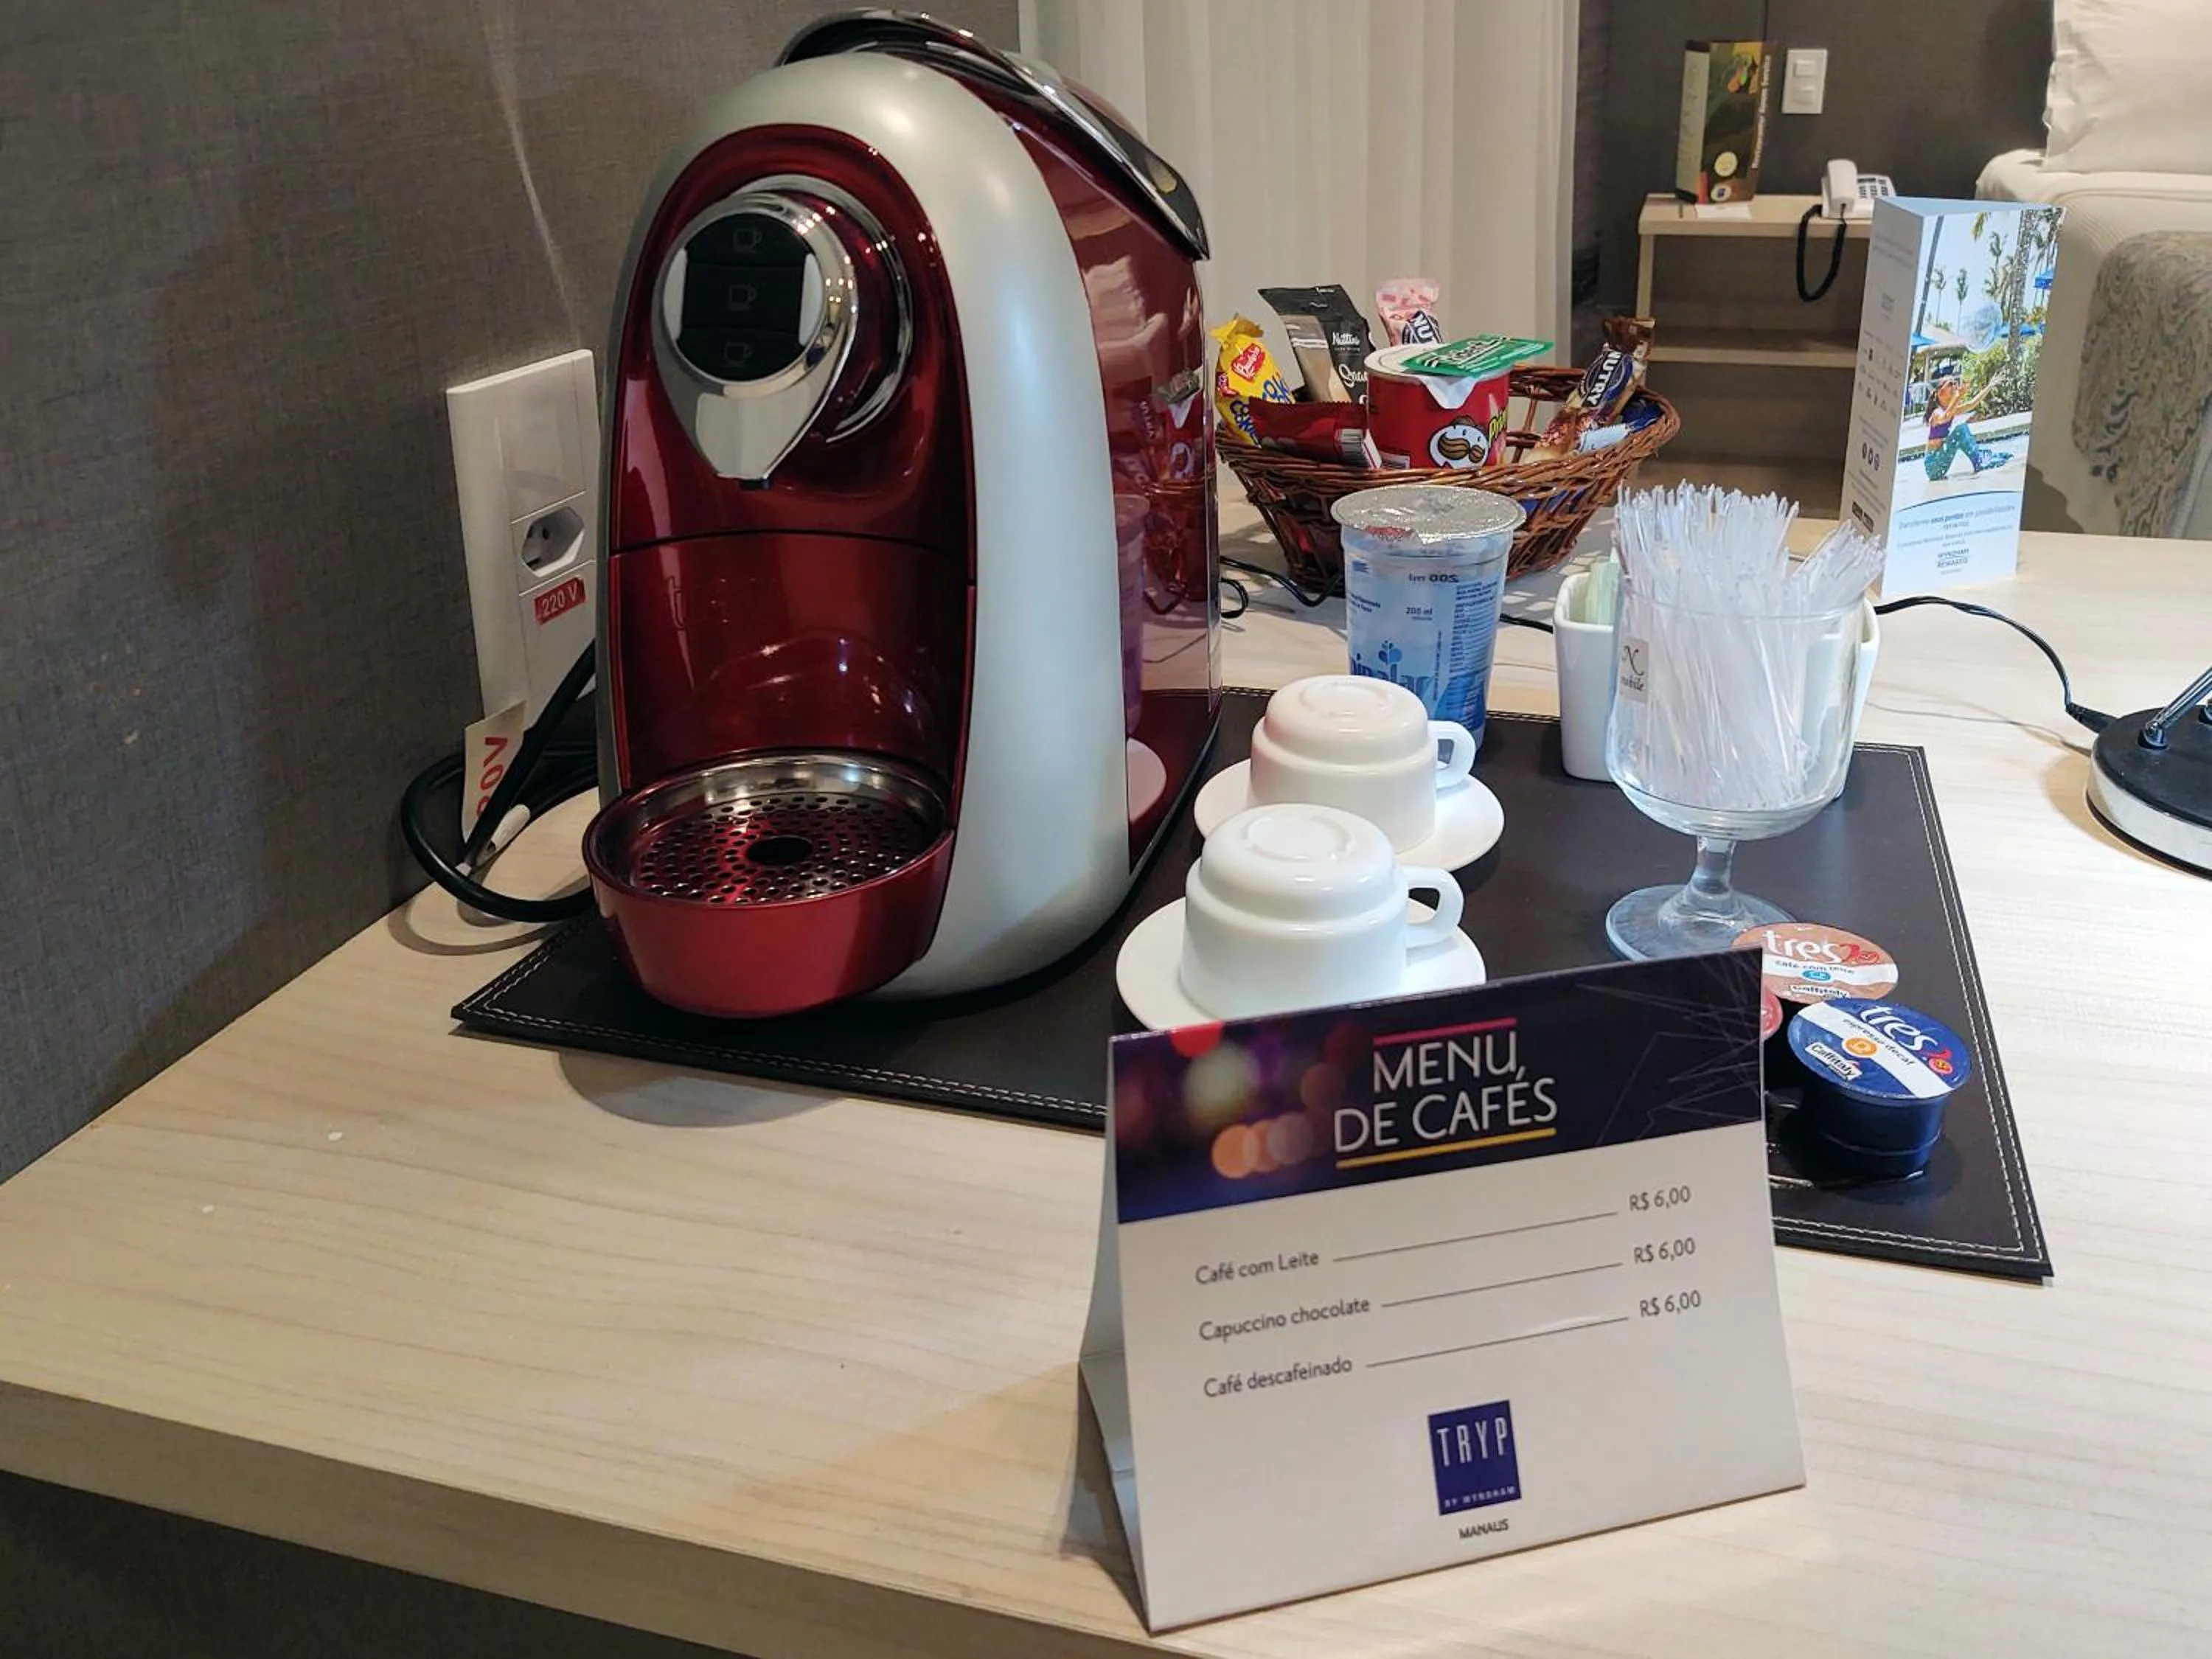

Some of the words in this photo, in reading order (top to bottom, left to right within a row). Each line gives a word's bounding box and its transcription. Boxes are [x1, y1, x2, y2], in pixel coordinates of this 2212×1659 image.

[1586, 350, 1622, 406] NUTRY
[542, 593, 564, 616] 220
[569, 583, 579, 602] V
[1860, 1006, 1938, 1051] tres
[1885, 1043, 1916, 1066] decaf
[1374, 1031, 1517, 1093] MENU
[1811, 1043, 1857, 1077] Caffitaly
[1334, 1102, 1399, 1152] DE
[1412, 1065, 1558, 1140] CAFÉS
[1195, 1262, 1234, 1284] Café
[1239, 1260, 1274, 1277] com
[1279, 1252, 1319, 1271] Leite
[1629, 1192, 1649, 1211] R$
[1654, 1185, 1691, 1209] 6,00
[1199, 1313, 1287, 1343] Capuccino
[1291, 1298, 1371, 1325] chocolate
[1634, 1244, 1654, 1264] R$
[1658, 1237, 1695, 1261] 6,00
[1204, 1374, 1242, 1398] Café
[1247, 1356, 1353, 1390] descafeinado
[1640, 1297, 1660, 1318] R$
[1664, 1290, 1701, 1315] 6,00
[1436, 1416, 1509, 1467] TRYP
[1458, 1517, 1509, 1540] MANAUS
